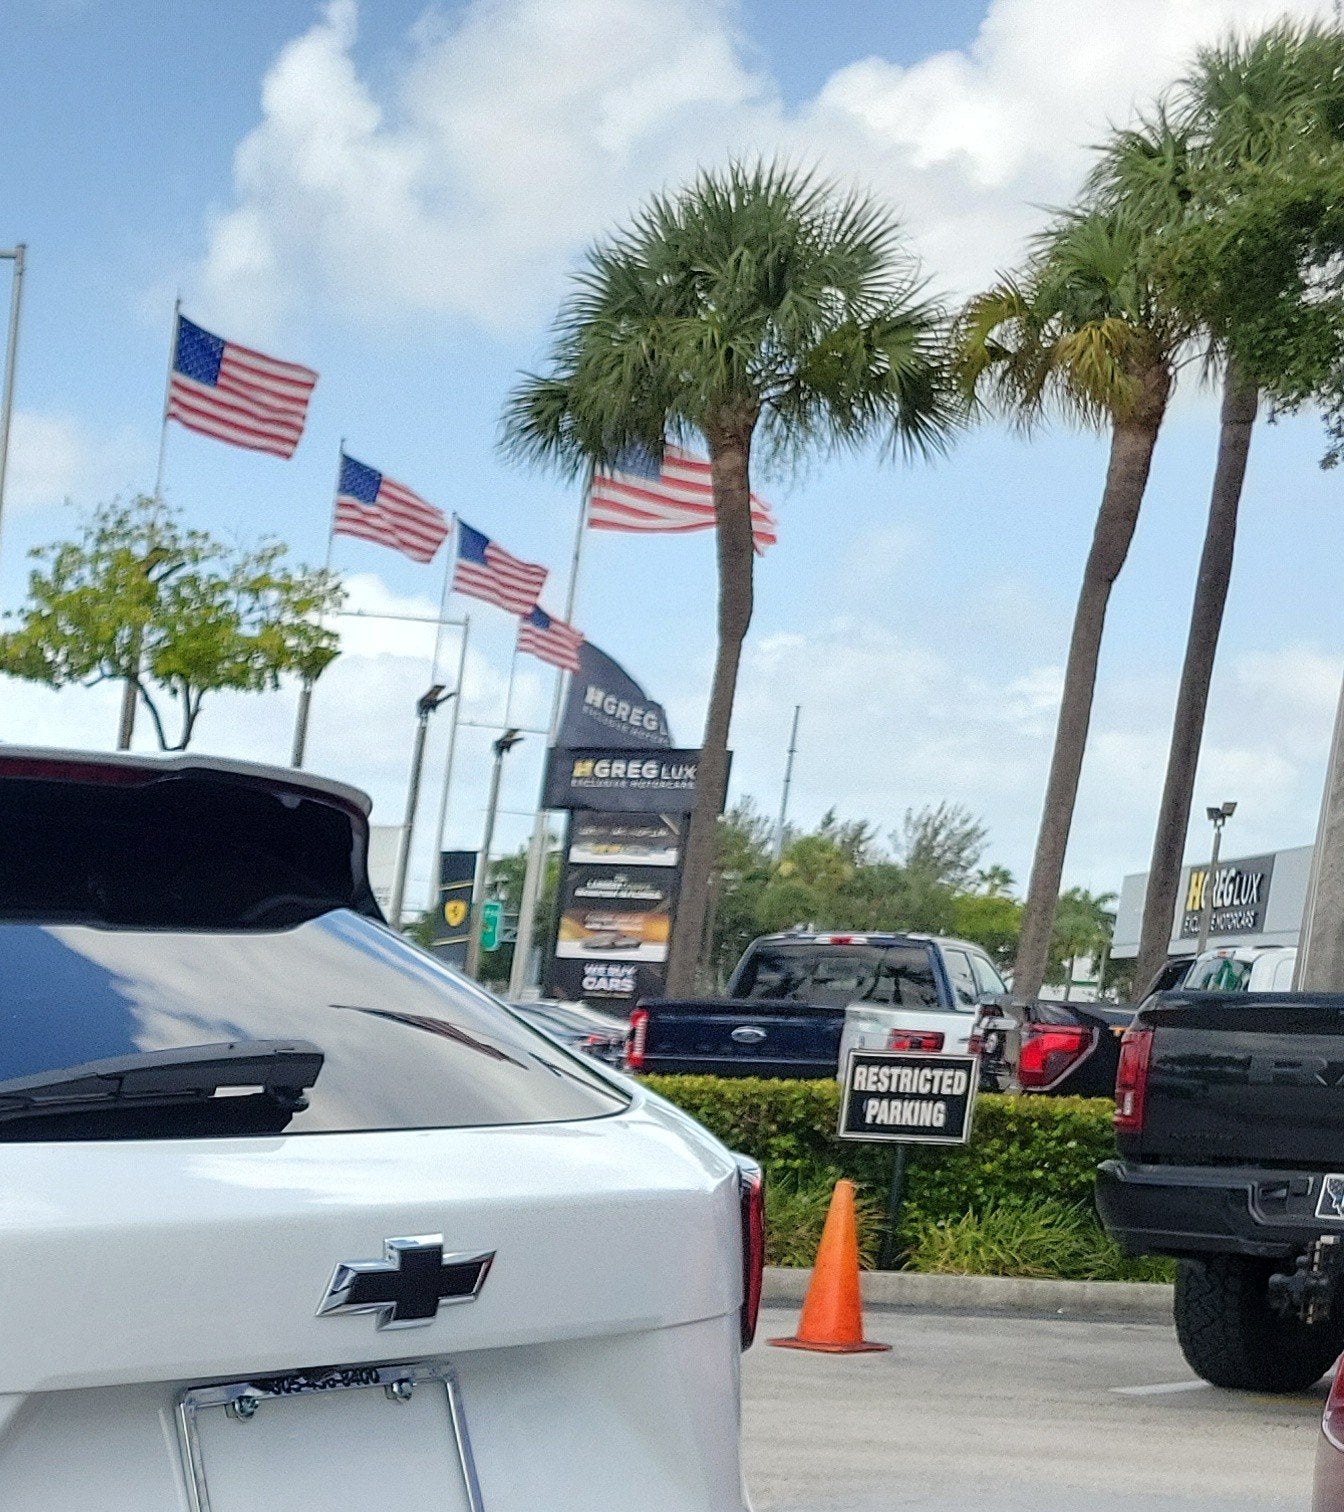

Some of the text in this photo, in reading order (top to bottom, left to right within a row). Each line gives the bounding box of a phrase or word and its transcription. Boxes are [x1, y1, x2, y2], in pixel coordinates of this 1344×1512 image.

[581, 975, 636, 992] CARS
[853, 1064, 968, 1096] RESTRICTED
[864, 1097, 947, 1128] PARKING
